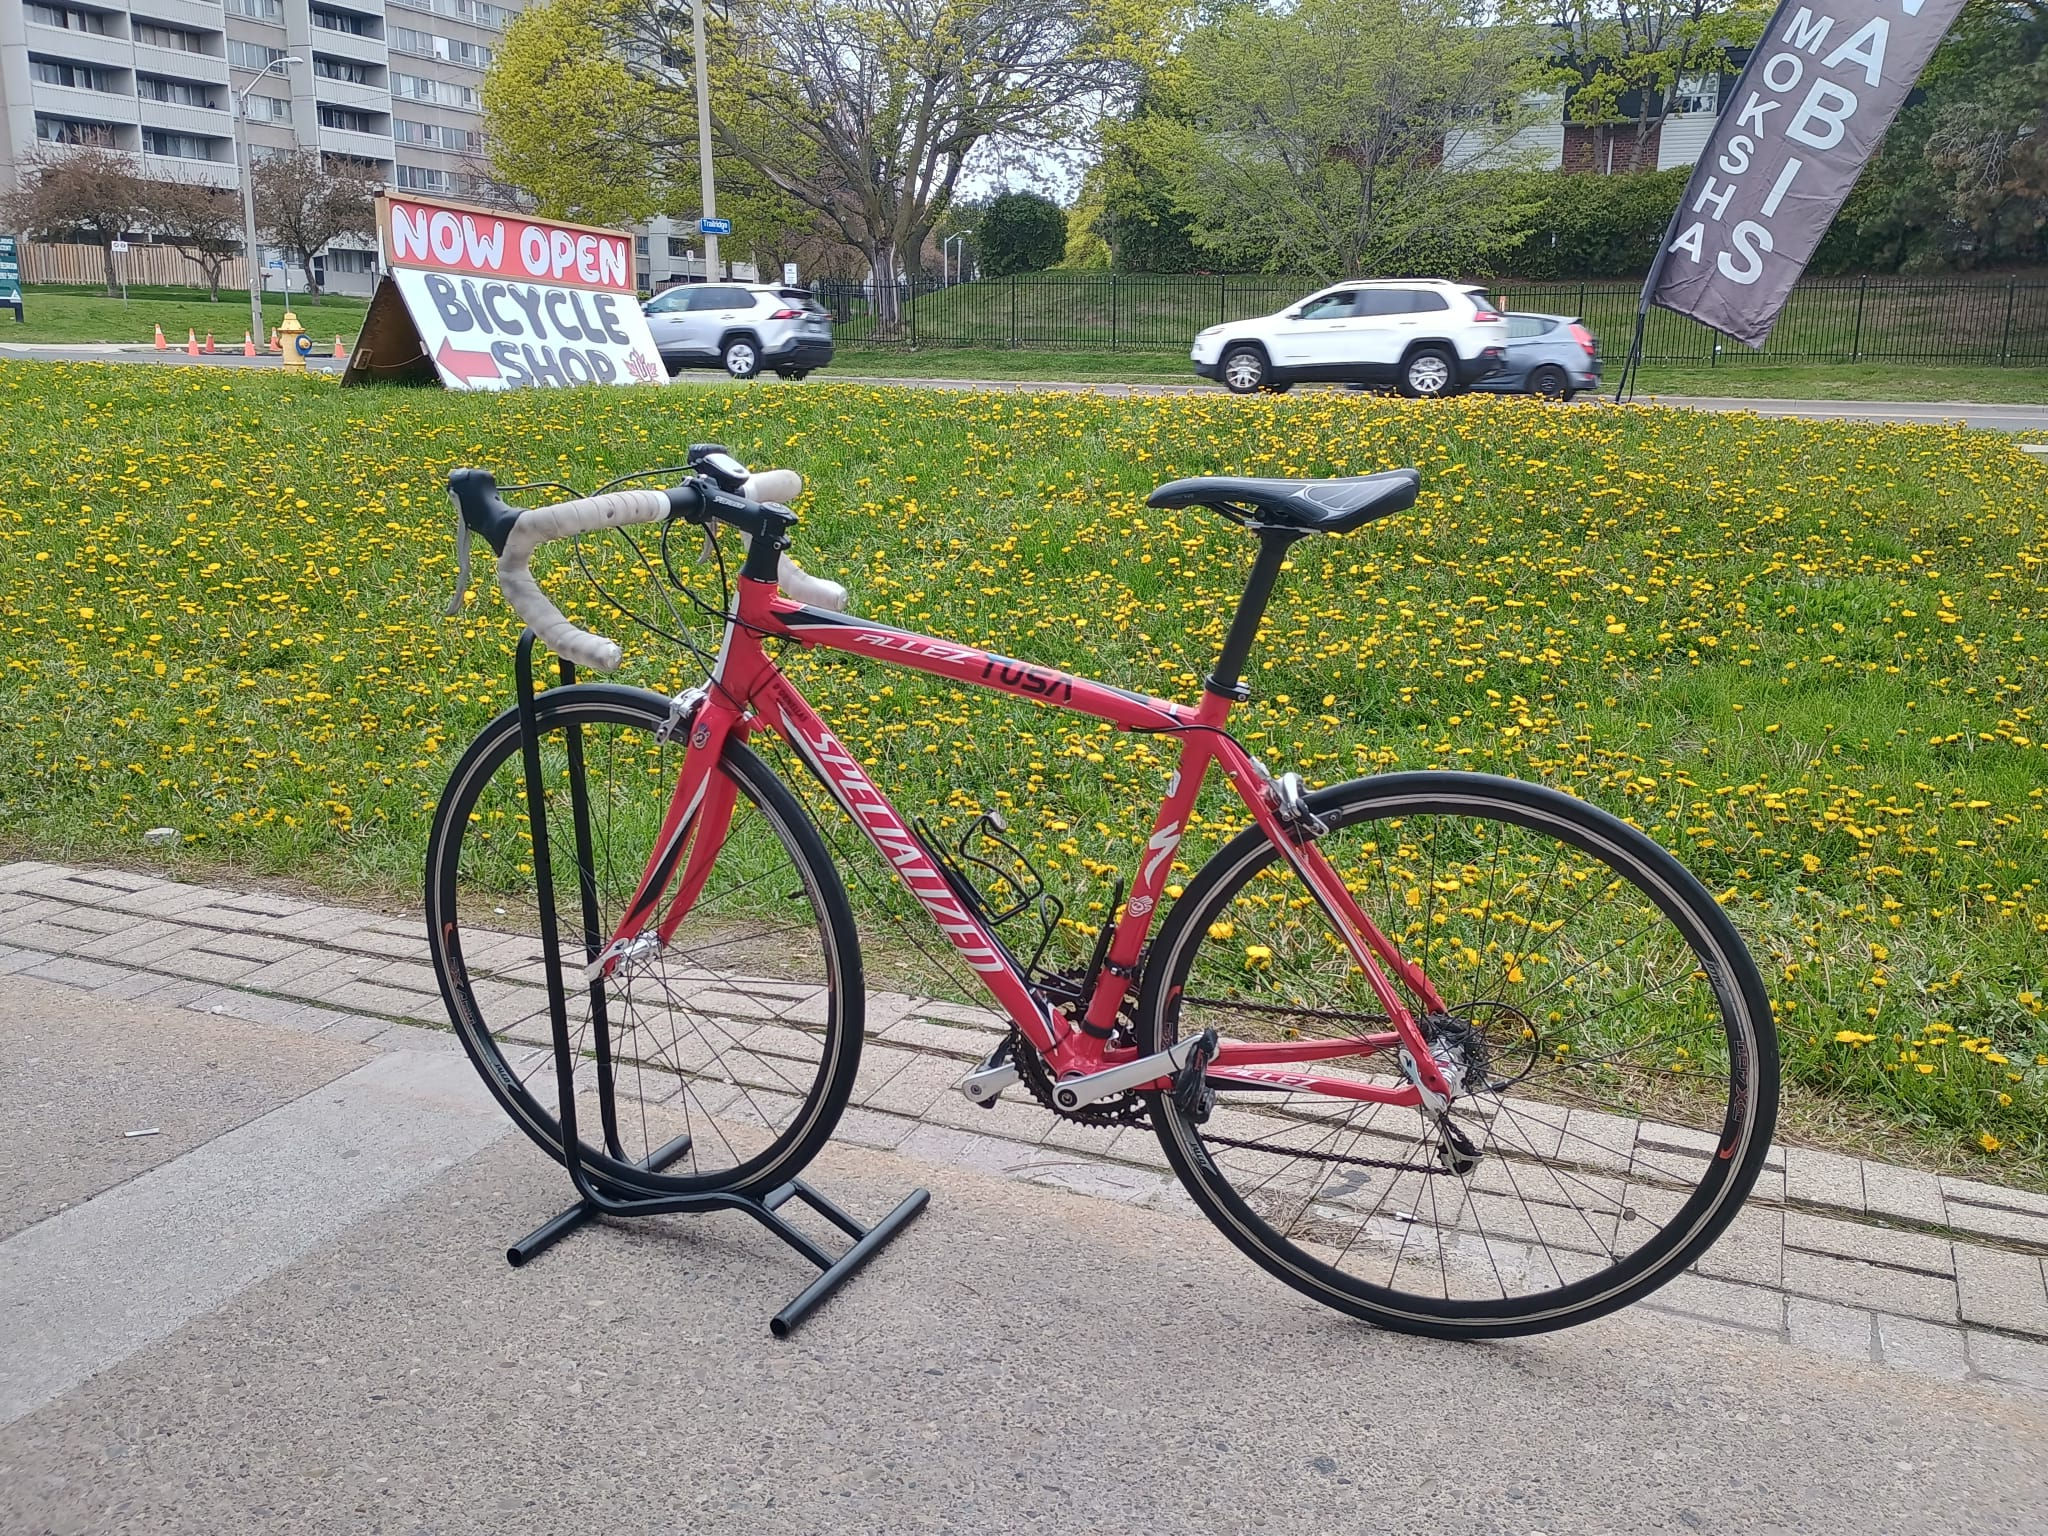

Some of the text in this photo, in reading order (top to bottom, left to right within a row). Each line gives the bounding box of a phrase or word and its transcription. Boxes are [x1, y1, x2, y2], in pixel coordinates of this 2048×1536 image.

[1668, 7, 1835, 264] MOKSHA
[1716, 0, 1928, 285] ABIS
[391, 205, 627, 287] NOW OPEN
[424, 274, 630, 345] BICYCLE
[490, 341, 617, 388] SHOP
[853, 633, 979, 665] ALLEZ
[802, 728, 1004, 972] SPECIALIZED
[1224, 1068, 1320, 1090] ALLEZ
